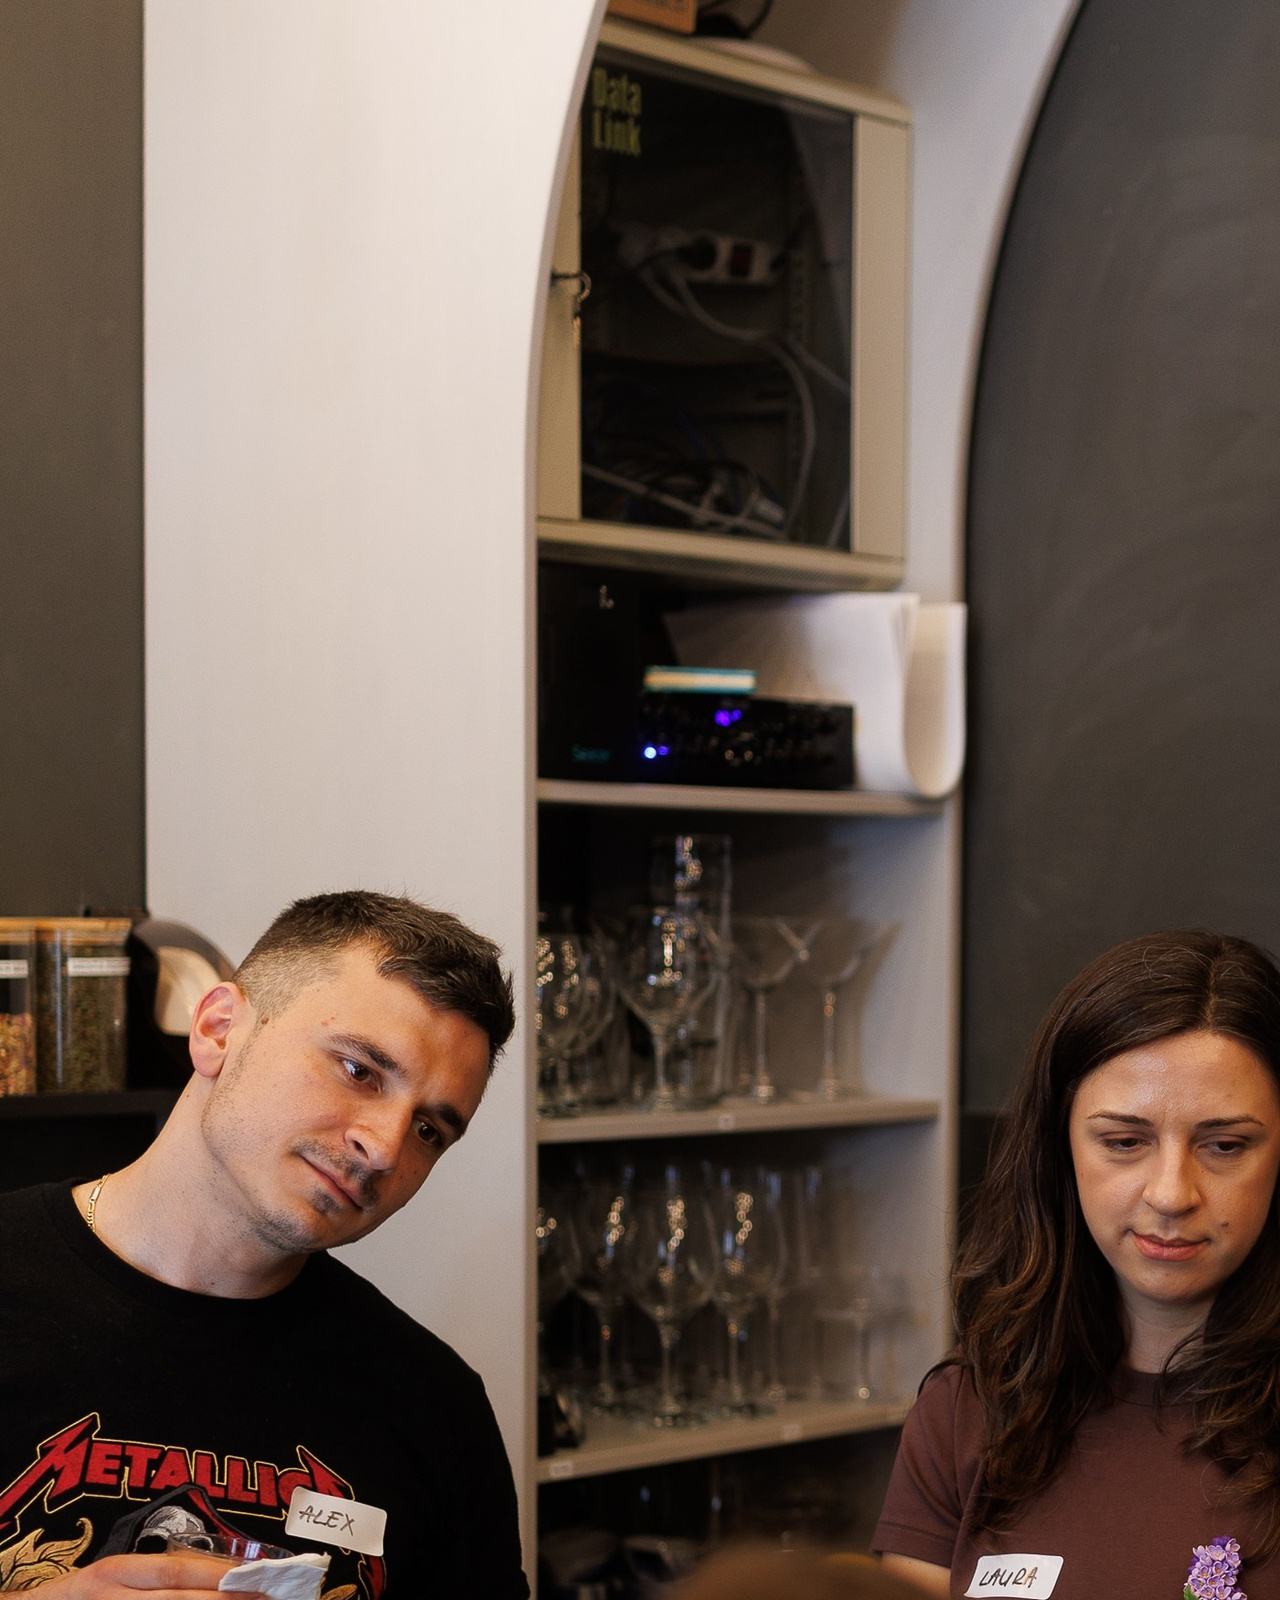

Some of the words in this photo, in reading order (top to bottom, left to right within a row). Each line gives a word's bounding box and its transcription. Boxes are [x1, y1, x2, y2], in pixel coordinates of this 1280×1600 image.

[592, 109, 642, 157] Link
[298, 1504, 356, 1537] ALEX
[978, 1566, 1039, 1589] LAURA
